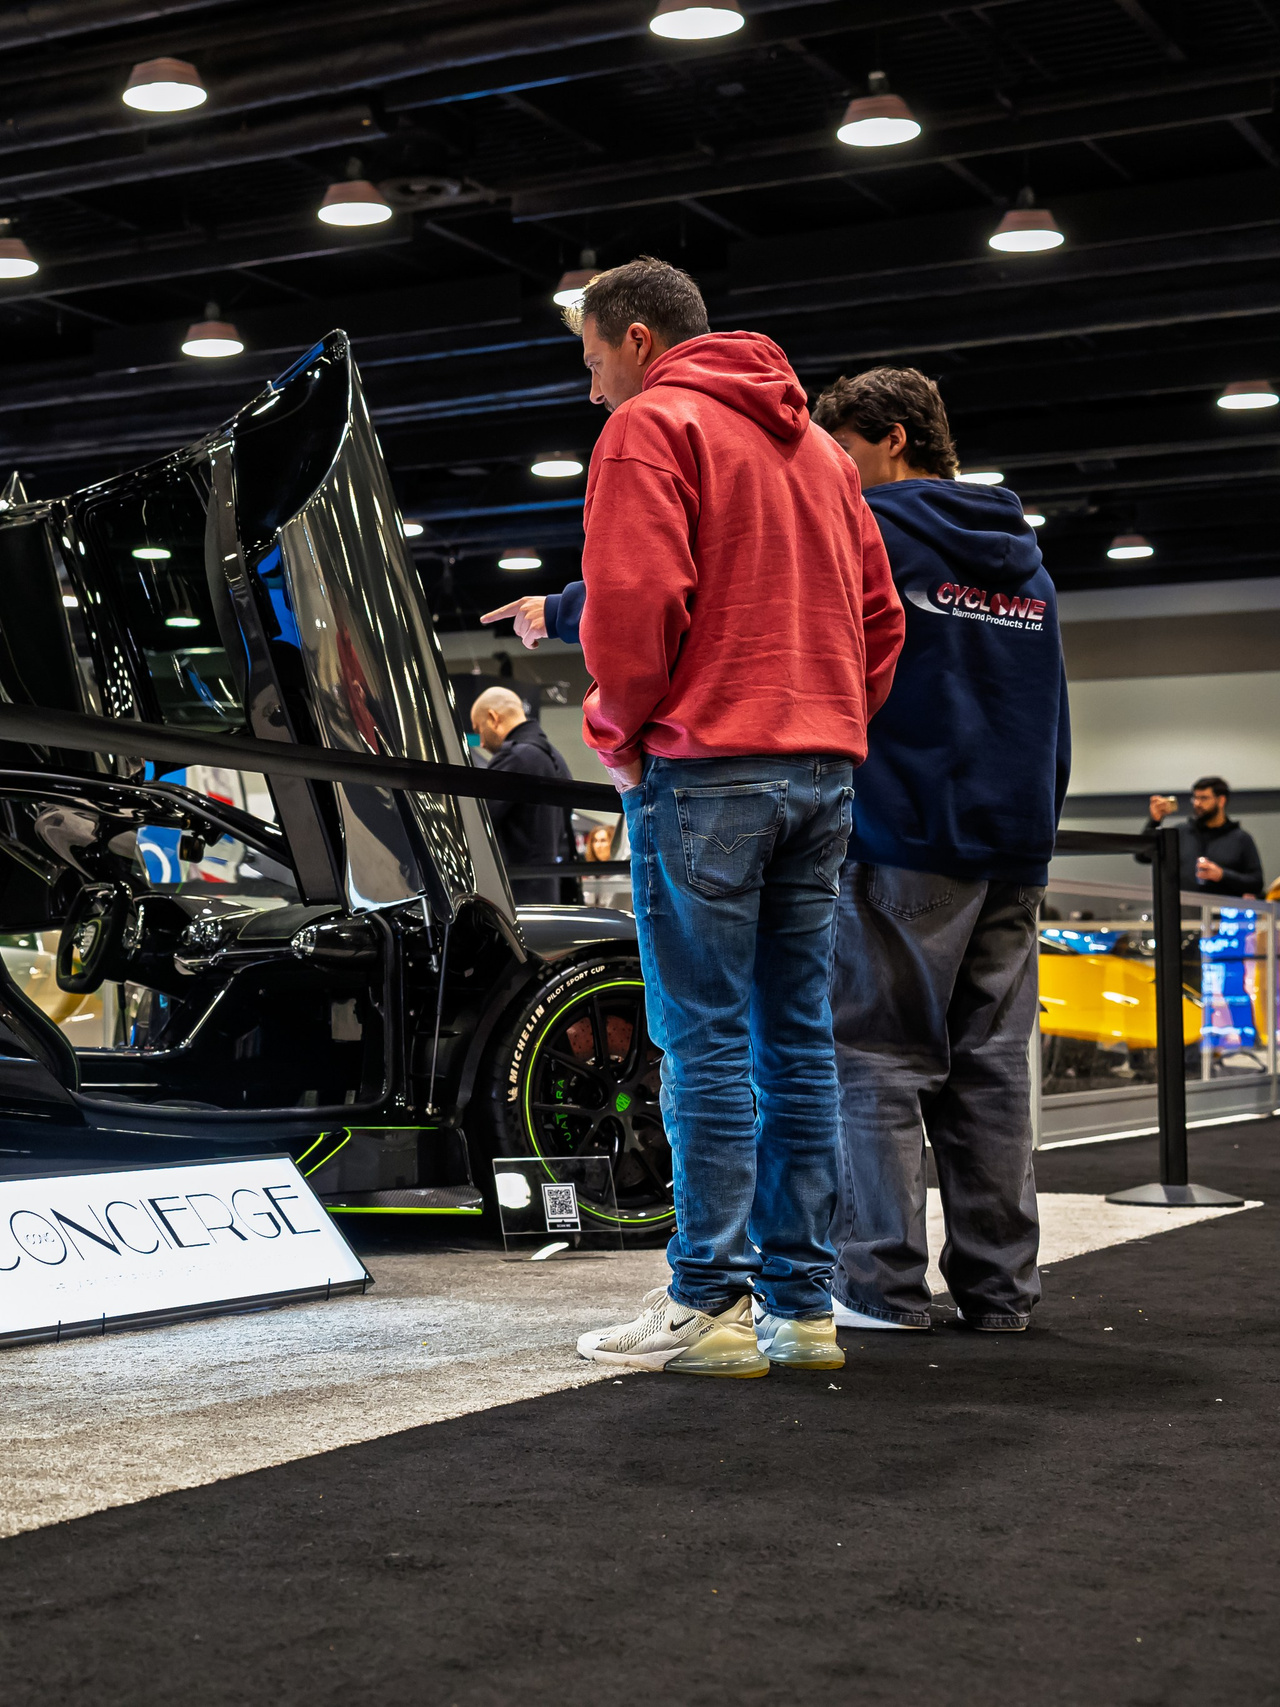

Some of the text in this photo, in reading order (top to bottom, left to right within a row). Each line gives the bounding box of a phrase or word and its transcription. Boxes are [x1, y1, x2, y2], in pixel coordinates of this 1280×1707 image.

[936, 582, 1047, 621] CYCLONE
[952, 607, 1044, 631] Diamond Products Ltd.
[508, 965, 606, 1084] MICHELIN PILOT SPORT CUP
